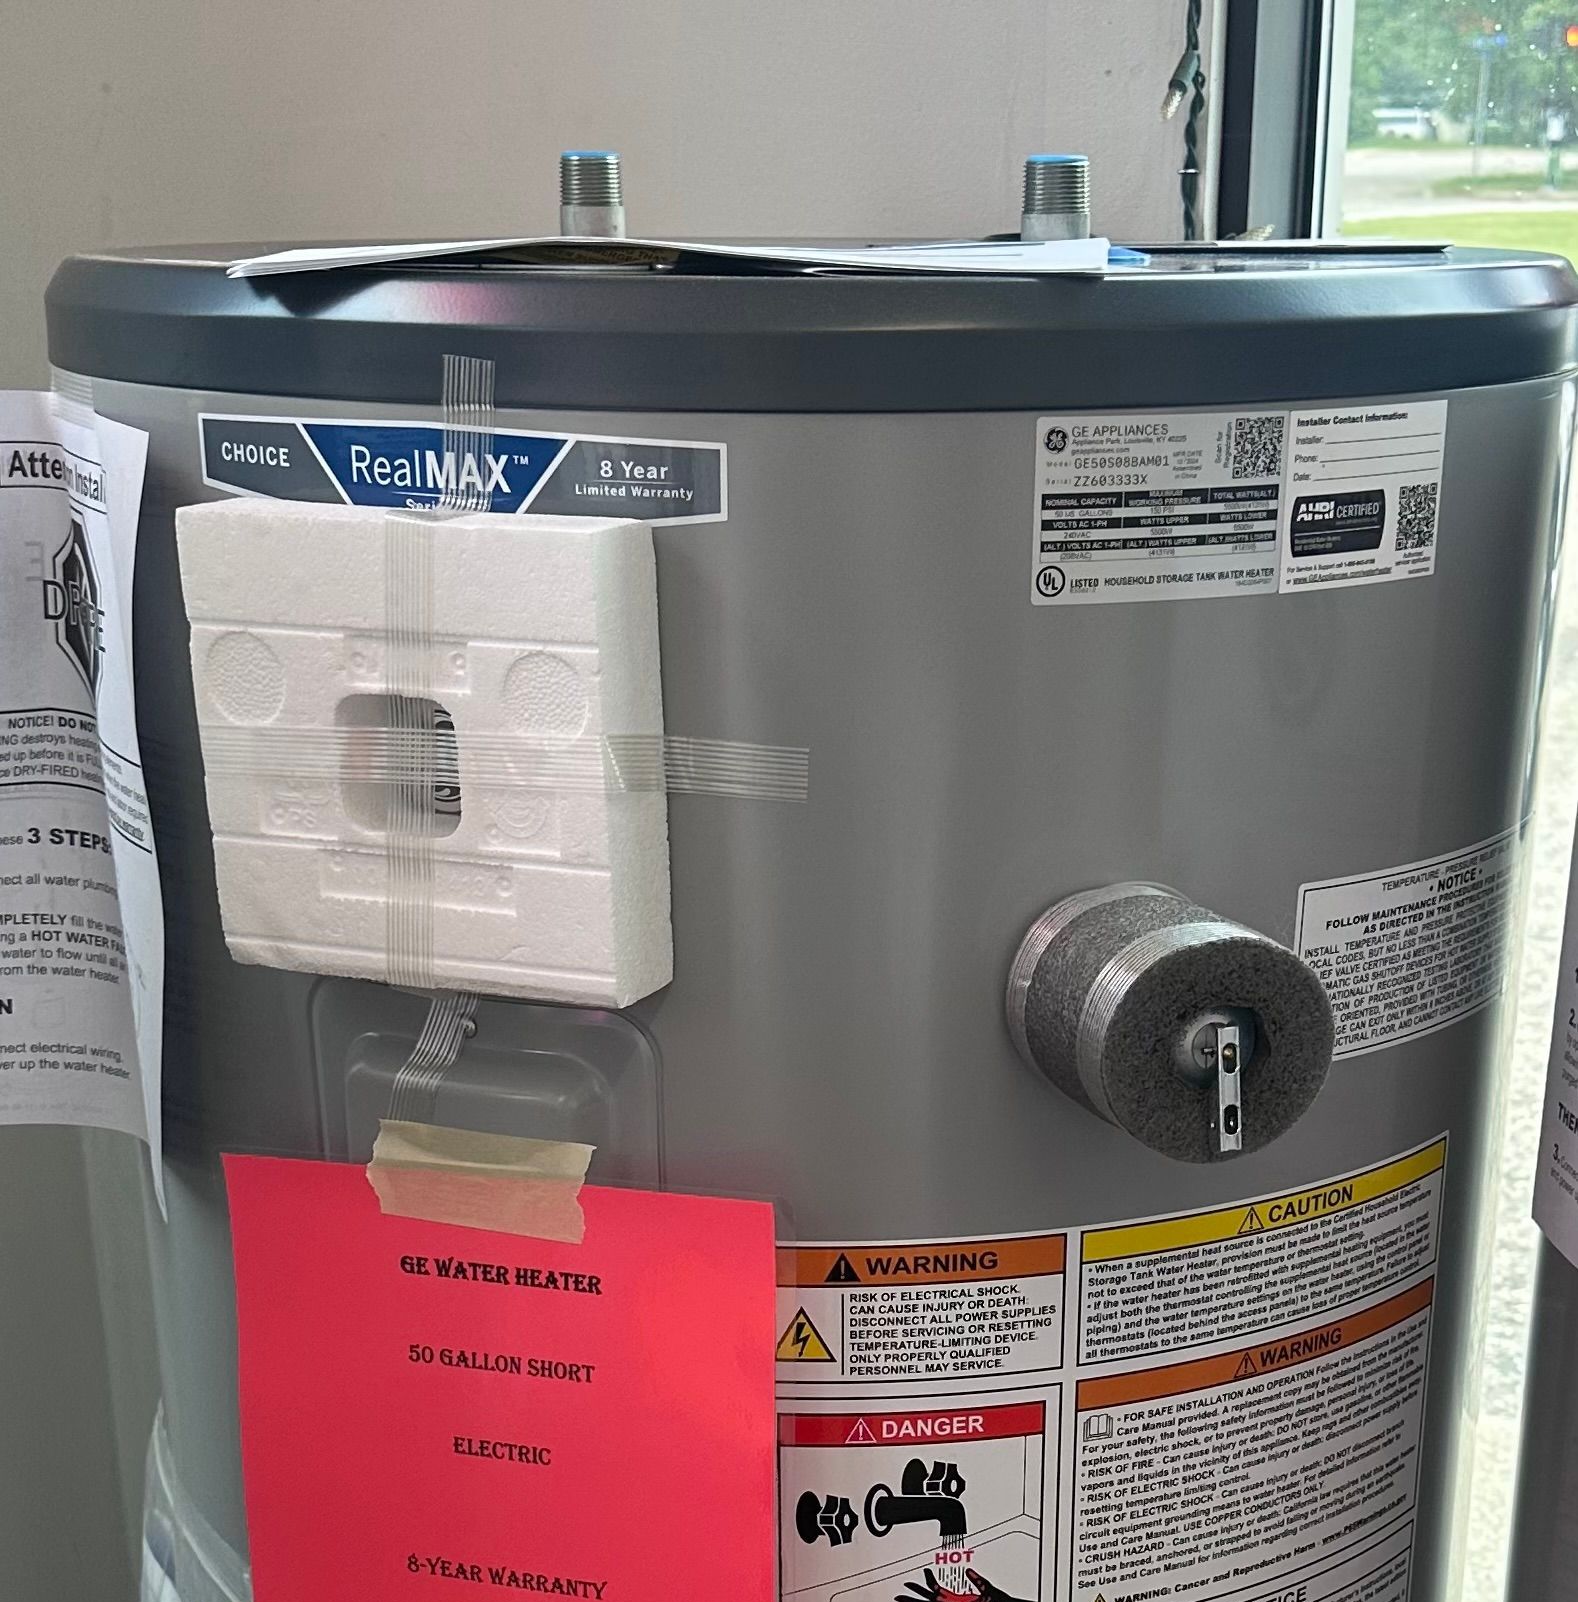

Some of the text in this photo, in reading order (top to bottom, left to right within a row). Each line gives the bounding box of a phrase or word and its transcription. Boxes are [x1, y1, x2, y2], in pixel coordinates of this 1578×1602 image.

[1072, 424, 1169, 437] GE APPLIANCES
[1297, 417, 1331, 427] Installer
[1333, 415, 1363, 424] Contact
[221, 442, 291, 467] CHOICE
[1295, 455, 1318, 463] Phone:
[600, 461, 668, 481] 8 Year
[1293, 473, 1311, 482] Date:
[1074, 475, 1148, 487] ZZ603333X
[575, 484, 693, 501] Limited Warranty
[1080, 497, 1117, 505] CAPACITY
[1336, 502, 1380, 518] CERTIFIED
[1166, 516, 1189, 524] UPPER
[1070, 568, 1274, 588] LISTED HOUSEHOLD STORAGE TANK WATER HEATER
[8, 715, 54, 729] NOTICE!
[58, 717, 77, 728] DO
[21, 733, 66, 748] destroys
[13, 750, 64, 763] up before
[13, 765, 79, 778] DRY-FIRED
[27, 827, 41, 844] 3
[26, 873, 80, 887] all water
[1437, 867, 1476, 892] NOTICE
[71, 915, 84, 927] fill
[1326, 896, 1437, 930] FOLLOW MAINTENANCE
[1363, 911, 1424, 935] AS DIRECTED
[32, 930, 109, 949] HOT WATER
[2, 947, 83, 960] water to flow
[1304, 945, 1339, 959] INSTALL
[27, 964, 87, 977] the water
[30, 1042, 87, 1055] electrical
[19, 1058, 97, 1072] up the water
[1267, 1183, 1354, 1224] CAUTION
[866, 1251, 999, 1276] WARNING
[1095, 1263, 1124, 1274] When
[1135, 1251, 1199, 1268] supplemental
[1202, 1245, 1221, 1256] heat
[1224, 1236, 1254, 1252] source
[400, 1255, 602, 1295] GE WATER HEATER
[1088, 1259, 1219, 1287] Storage Tank Water Heater,
[849, 1284, 1020, 1303] RISK OF ELECTRICAL SHOCK.
[849, 1295, 1029, 1315] CAN CAUSE INJURY OR DEATH.
[849, 1304, 1057, 1327] DISCONNECT ALL POWER SUPPLIES
[849, 1331, 1038, 1352] TEMPERATURE-LIMITING DEVICE.
[1259, 1328, 1343, 1368] WARNING
[408, 1344, 596, 1383] 50 GALLON SHORT
[849, 1345, 1011, 1364] ONLY PROPERLY QUALIFIED
[1123, 1391, 1243, 1423] FOR SAFE INSTALLATION
[882, 1415, 985, 1438] DANGER
[1116, 1418, 1176, 1436] Care Manual
[453, 1436, 552, 1466] ELECTRIC
[1087, 1459, 1154, 1479] RISK OF FIRE
[1130, 1470, 1215, 1496] ELECTRIC SHOCK
[935, 1550, 974, 1565] HOT
[1085, 1542, 1165, 1565] CRUSH HAZARD
[407, 1552, 608, 1600] 8-YEAR WARRANTY
[1174, 1577, 1210, 1592] Cancer
[1212, 1571, 1230, 1583] and
[1233, 1551, 1292, 1576] Reproductive
